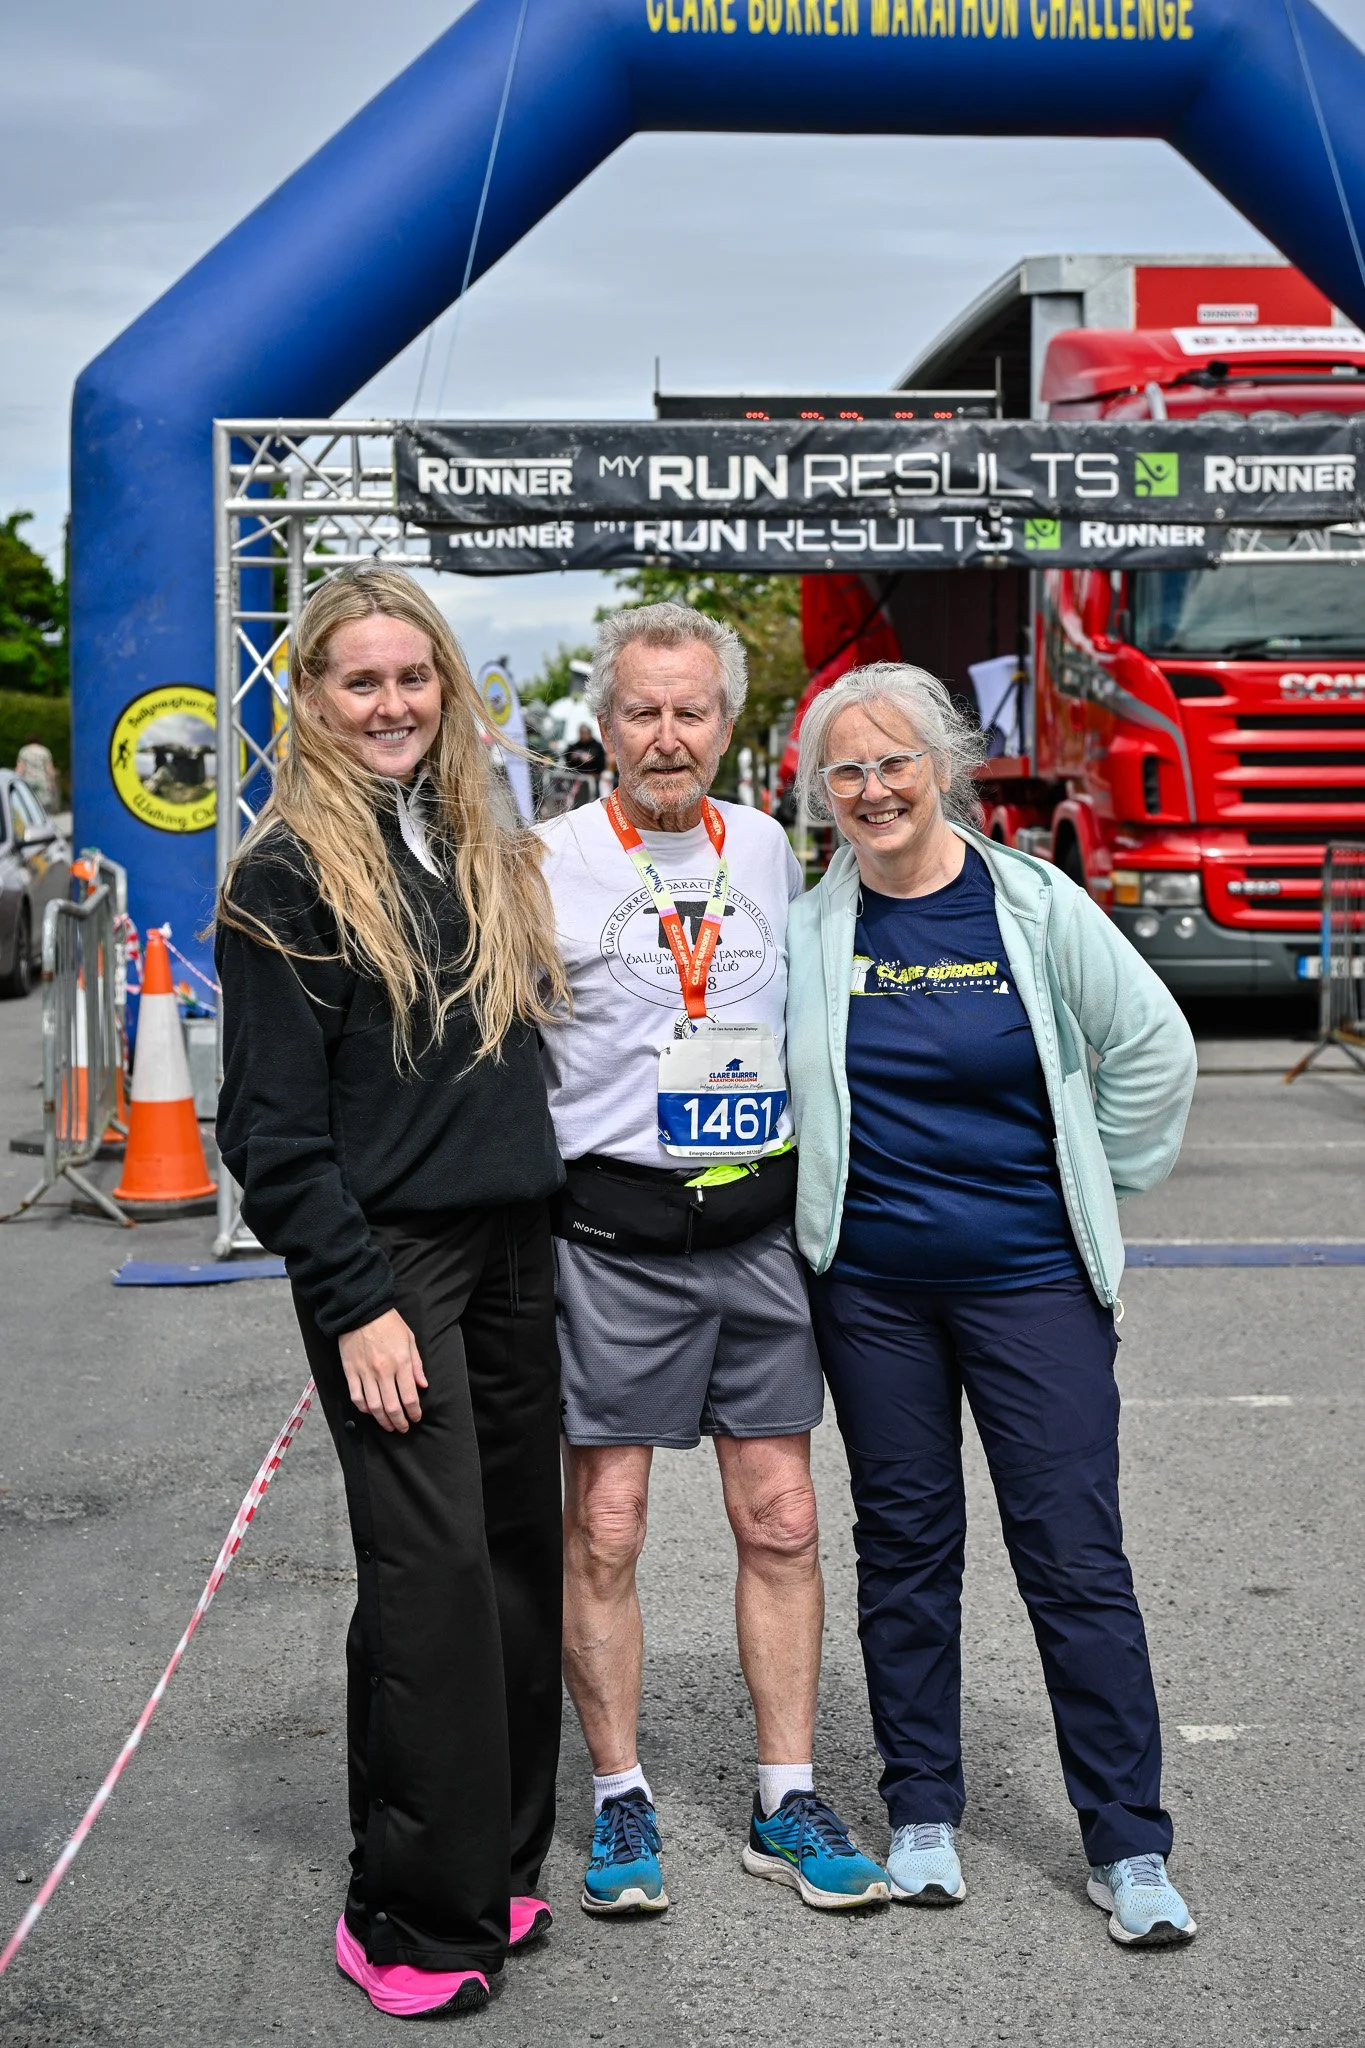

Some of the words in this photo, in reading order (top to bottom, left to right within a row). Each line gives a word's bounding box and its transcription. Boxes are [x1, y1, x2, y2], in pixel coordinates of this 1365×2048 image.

[645, 0, 737, 34] CLARE
[748, 0, 859, 36] BURREN
[871, 0, 1019, 39] MARATHON
[1030, 0, 1194, 41] CHALLENGE
[417, 456, 574, 496] RUNNER
[599, 455, 643, 478] MY
[649, 454, 788, 500] RUN
[803, 452, 1119, 500] RESULTS
[1204, 454, 1357, 494] RUNNER
[634, 519, 747, 552] RUN
[757, 516, 1014, 552] RESULTS
[1080, 520, 1206, 548] RUNNER
[192, 803, 216, 823] Clu
[643, 863, 664, 894] MONKS
[713, 869, 727, 900] MONKS
[613, 890, 650, 922] BURRE
[671, 923, 685, 951] CLARE
[876, 964, 927, 984] CLARE
[925, 961, 998, 980] BURREN
[877, 981, 926, 991] MARATHON
[932, 980, 998, 988] CHALLENGE
[731, 1071, 758, 1079] BURREN
[683, 1096, 772, 1141] 1461
